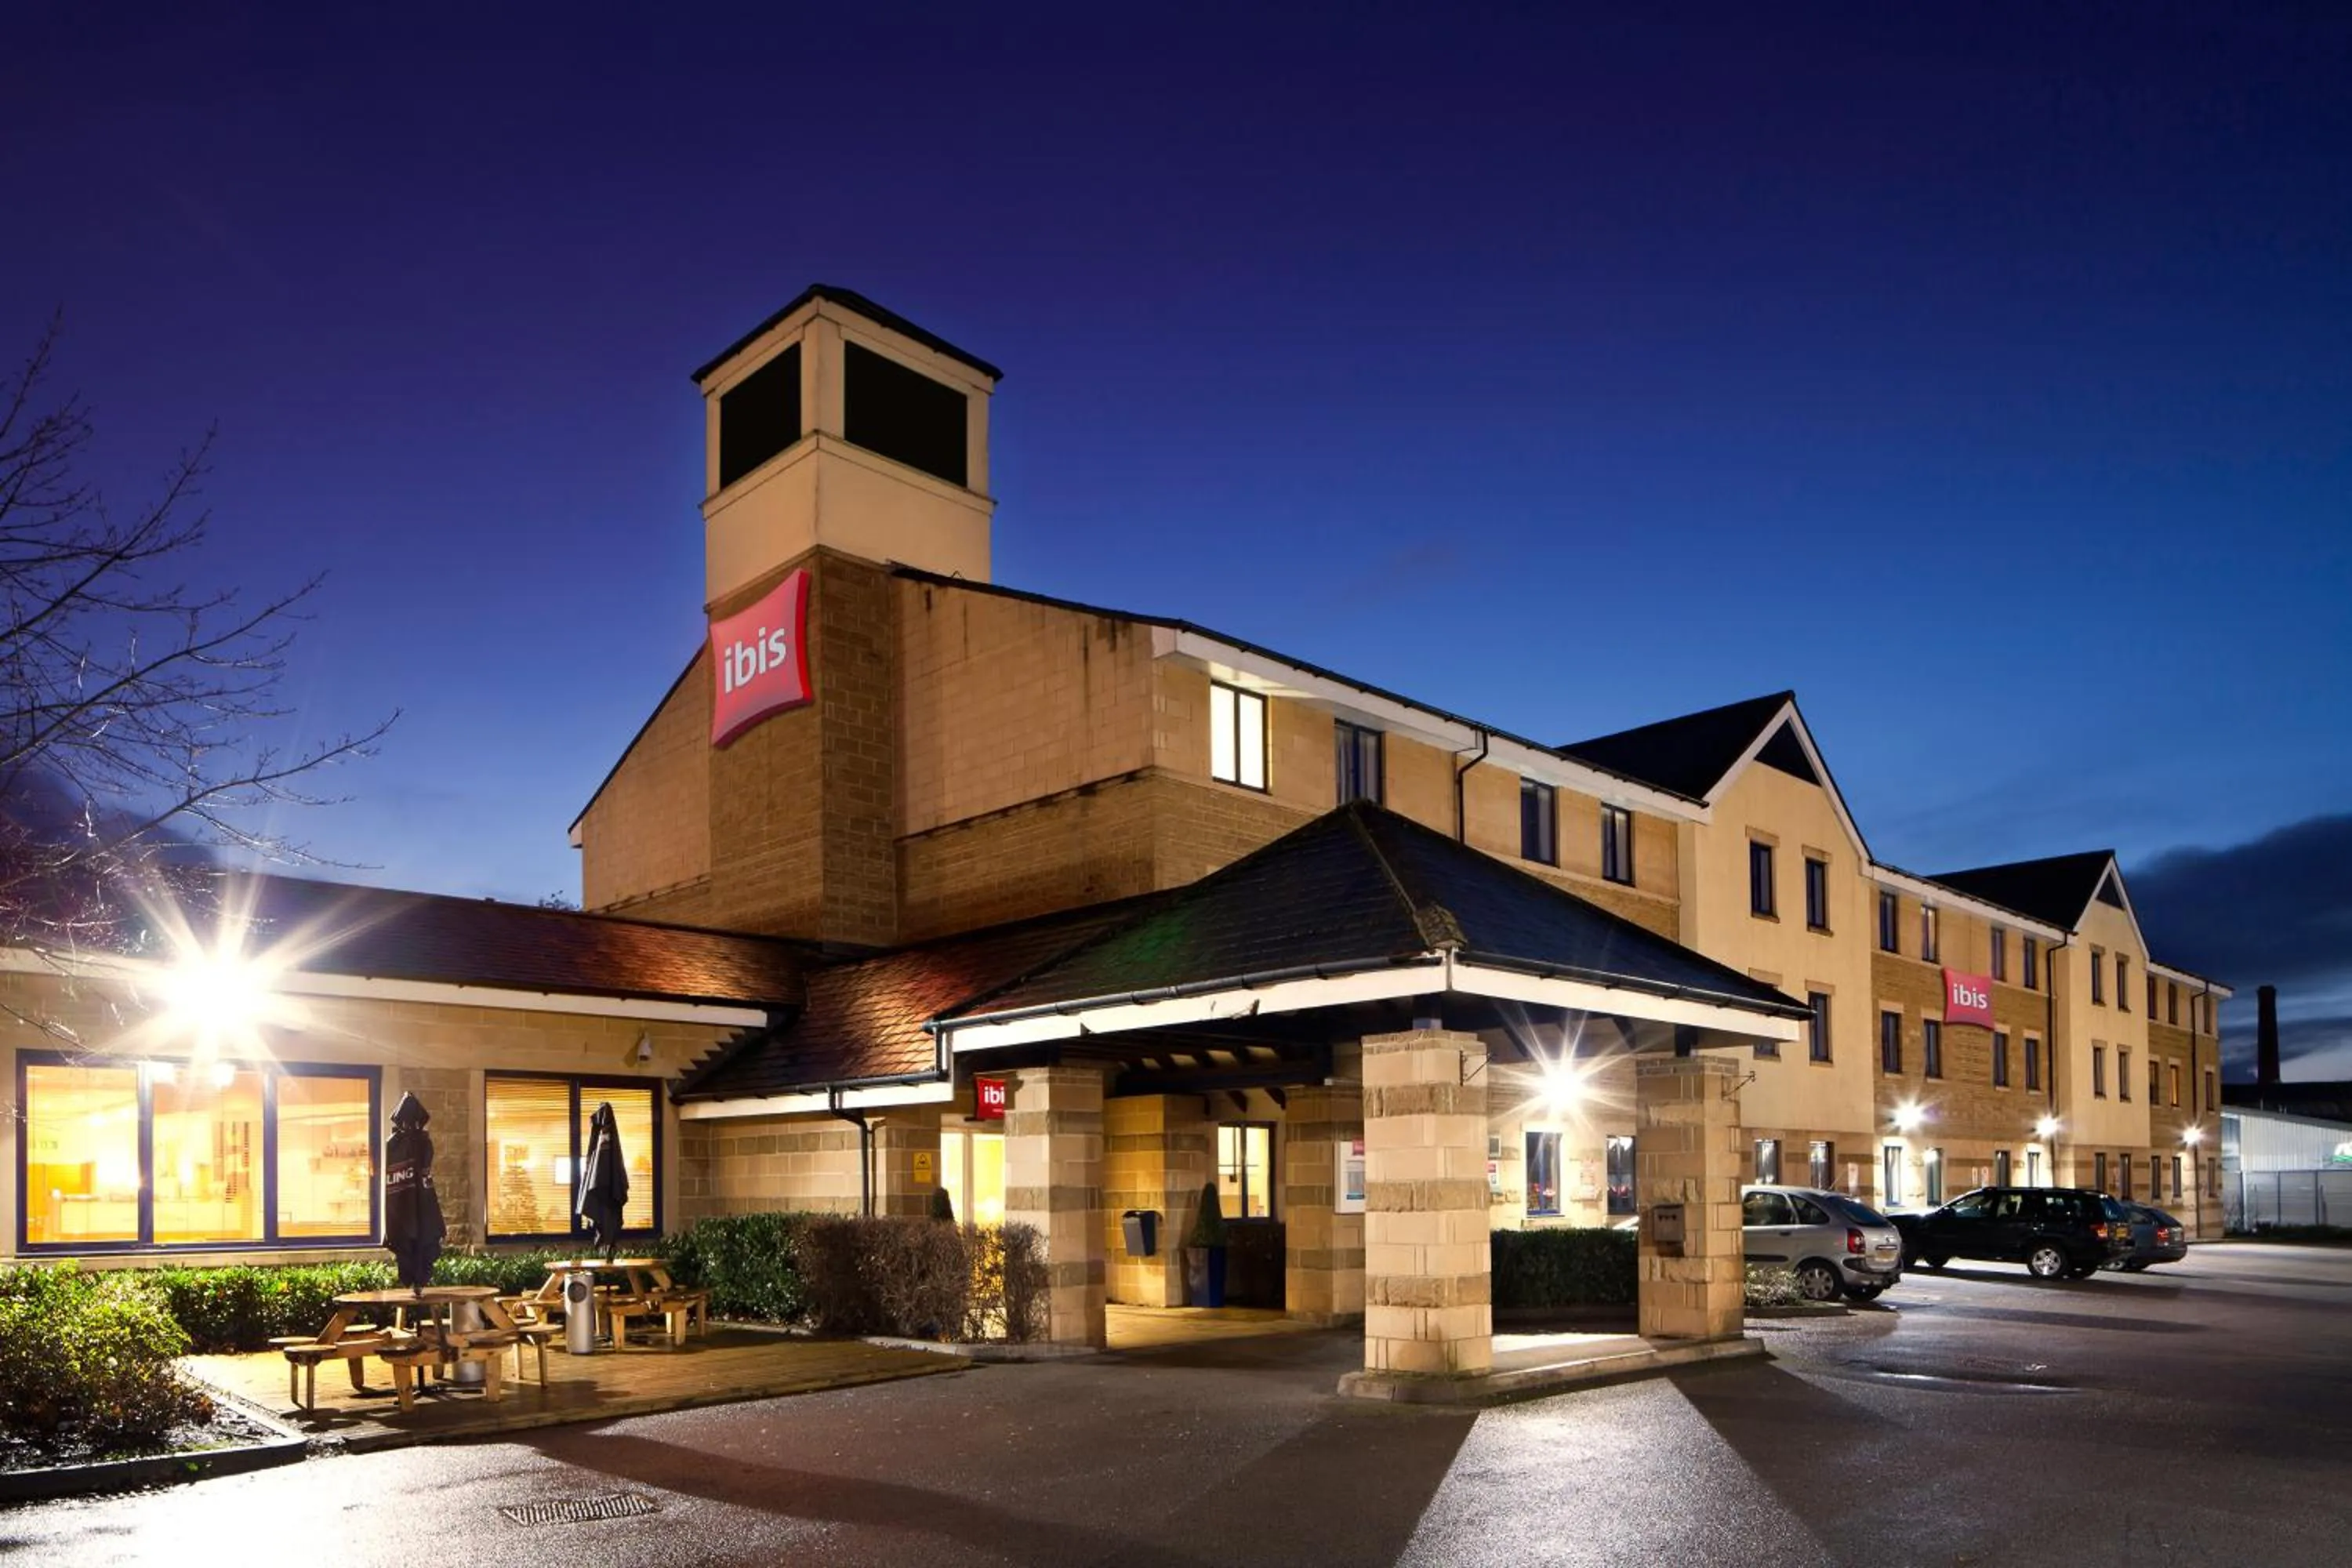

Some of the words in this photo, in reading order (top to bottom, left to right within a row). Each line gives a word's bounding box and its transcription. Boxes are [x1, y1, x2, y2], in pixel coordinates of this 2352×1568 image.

[724, 627, 786, 693] ibis
[1953, 984, 1987, 1008] ibis
[984, 1086, 1005, 1104] ibi
